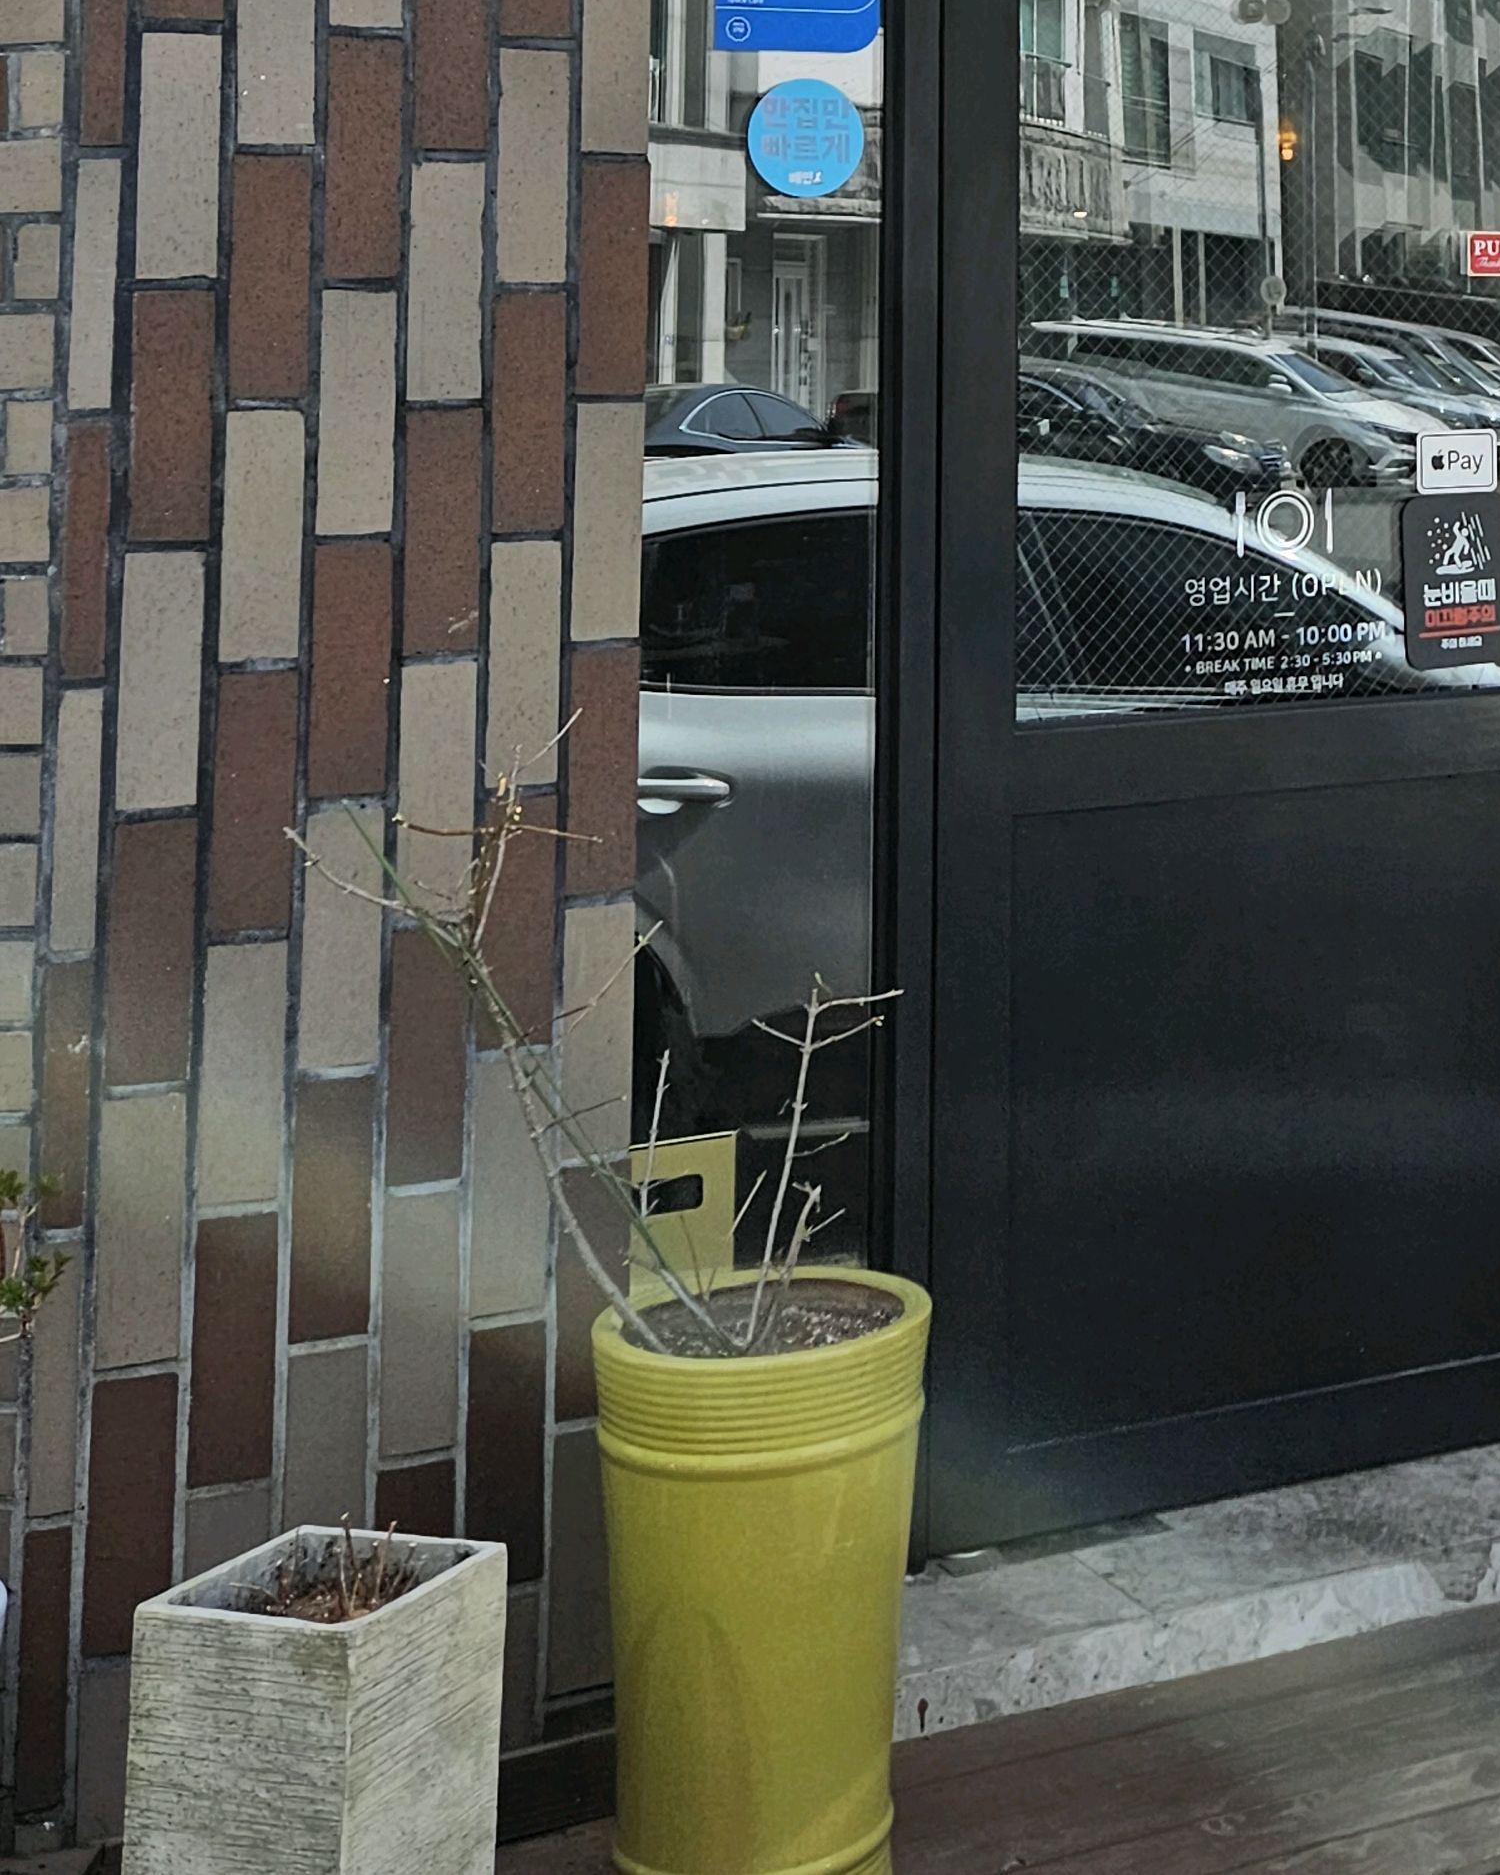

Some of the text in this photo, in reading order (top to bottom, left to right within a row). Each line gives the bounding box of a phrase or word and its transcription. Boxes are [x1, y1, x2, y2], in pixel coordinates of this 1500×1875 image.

[763, 133, 850, 164] 빠르게
[1447, 450, 1484, 475] Pay
[1184, 573, 1282, 607] 영업시간
[1181, 630, 1240, 653] 11:30
[1244, 628, 1276, 650] AM
[1296, 623, 1352, 646] 10:00
[1356, 620, 1387, 642] PM
[1195, 659, 1241, 675] BREAK
[1244, 656, 1276, 671] TIME
[1280, 654, 1311, 670] 2:30
[1321, 651, 1351, 666] 5:30
[1352, 650, 1373, 664] PM
[1250, 677, 1284, 695] 일요일
